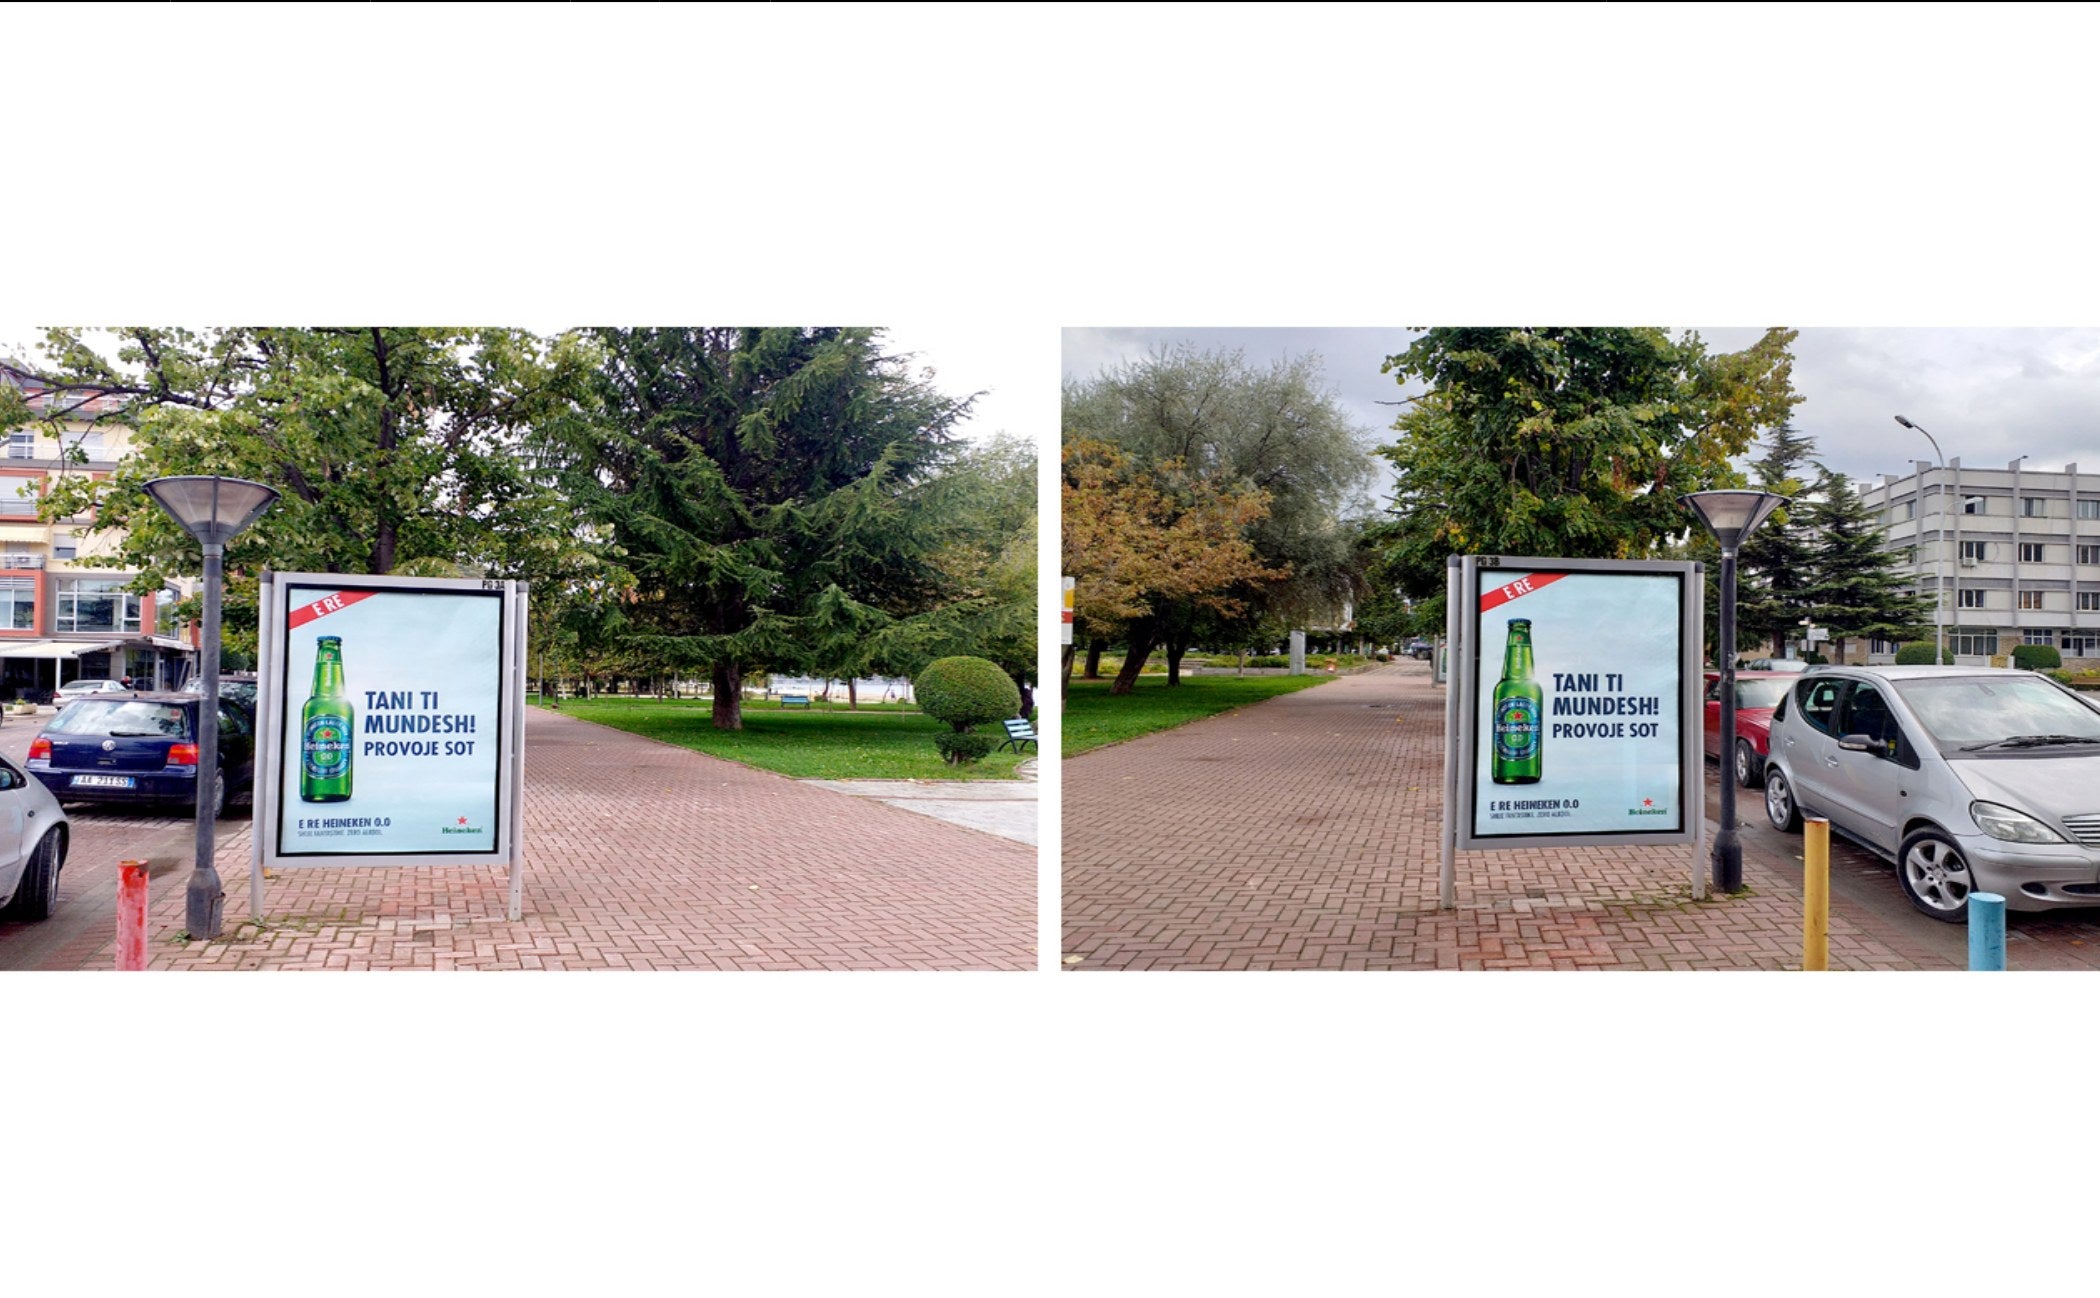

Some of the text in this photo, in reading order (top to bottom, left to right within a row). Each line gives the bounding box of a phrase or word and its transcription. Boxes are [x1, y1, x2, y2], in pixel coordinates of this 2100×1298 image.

[1503, 578, 1533, 600] E RE
[312, 594, 345, 616] E RE
[1553, 674, 1622, 692] TANI TI
[365, 691, 438, 710] TANI TI
[1553, 697, 1659, 716] MUNDESH!
[364, 715, 476, 733] MUNDESH!
[1553, 723, 1658, 738] PROVOJE SOT
[364, 741, 475, 756] PROVOJE SOT
[1490, 799, 1579, 811] E RE HEINEKEN 0.0
[299, 817, 391, 829] E RE HEINEKEN 0.0
